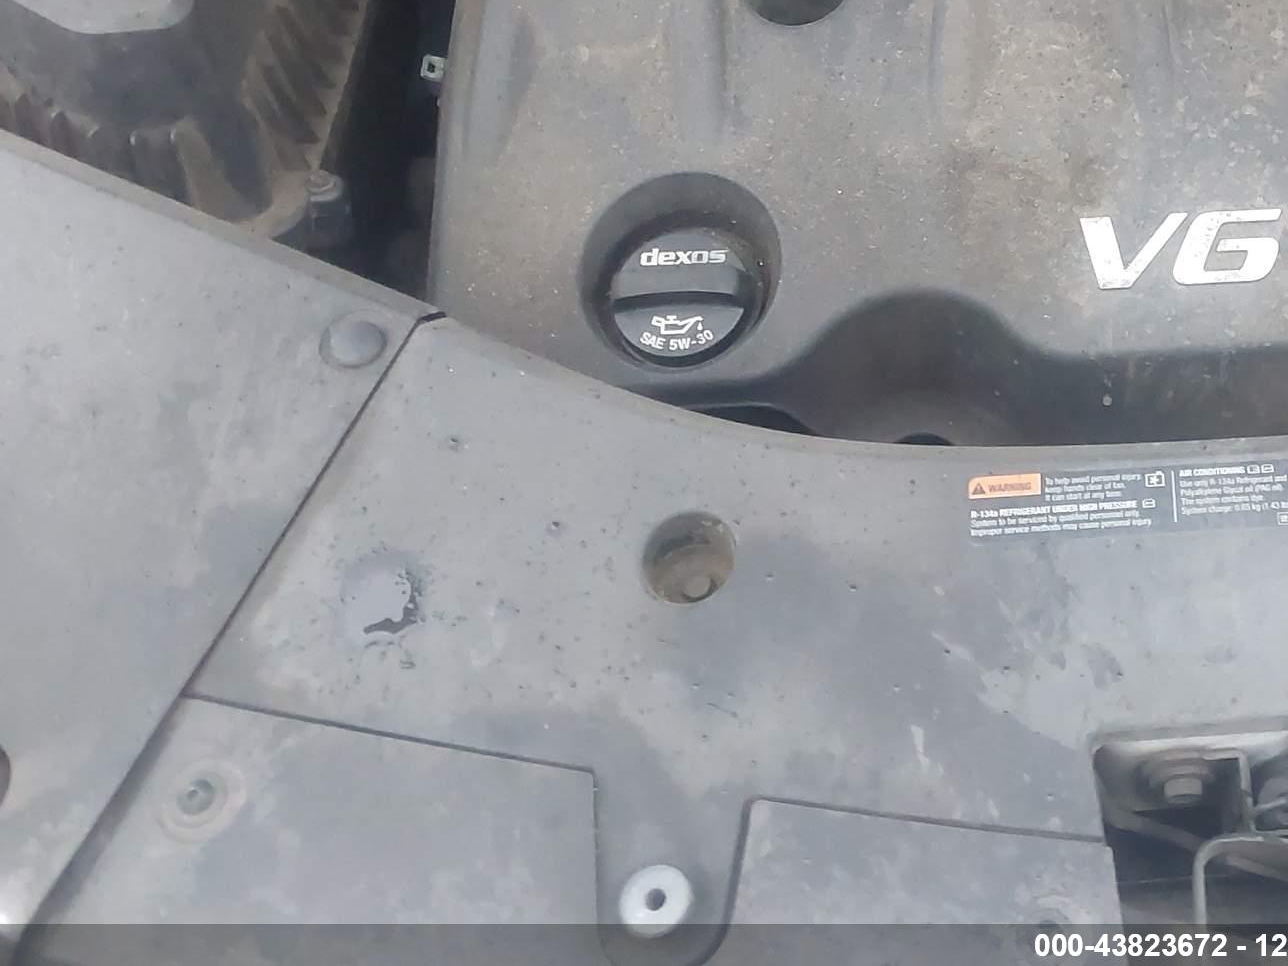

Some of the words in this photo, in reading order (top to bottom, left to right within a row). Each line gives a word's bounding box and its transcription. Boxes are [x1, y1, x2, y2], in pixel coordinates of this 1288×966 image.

[1080, 208, 1282, 289] V6
[640, 248, 730, 267] dexos
[640, 332, 666, 350] SAE
[669, 330, 714, 351] 5W-30
[1179, 469, 1193, 477] AIR
[1193, 466, 1246, 475] CONDITIONING
[988, 482, 1032, 492] WARNING
[971, 510, 998, 518] R-134a
[999, 505, 1050, 517] REFRIGERANT
[1051, 504, 1078, 513] UNDER
